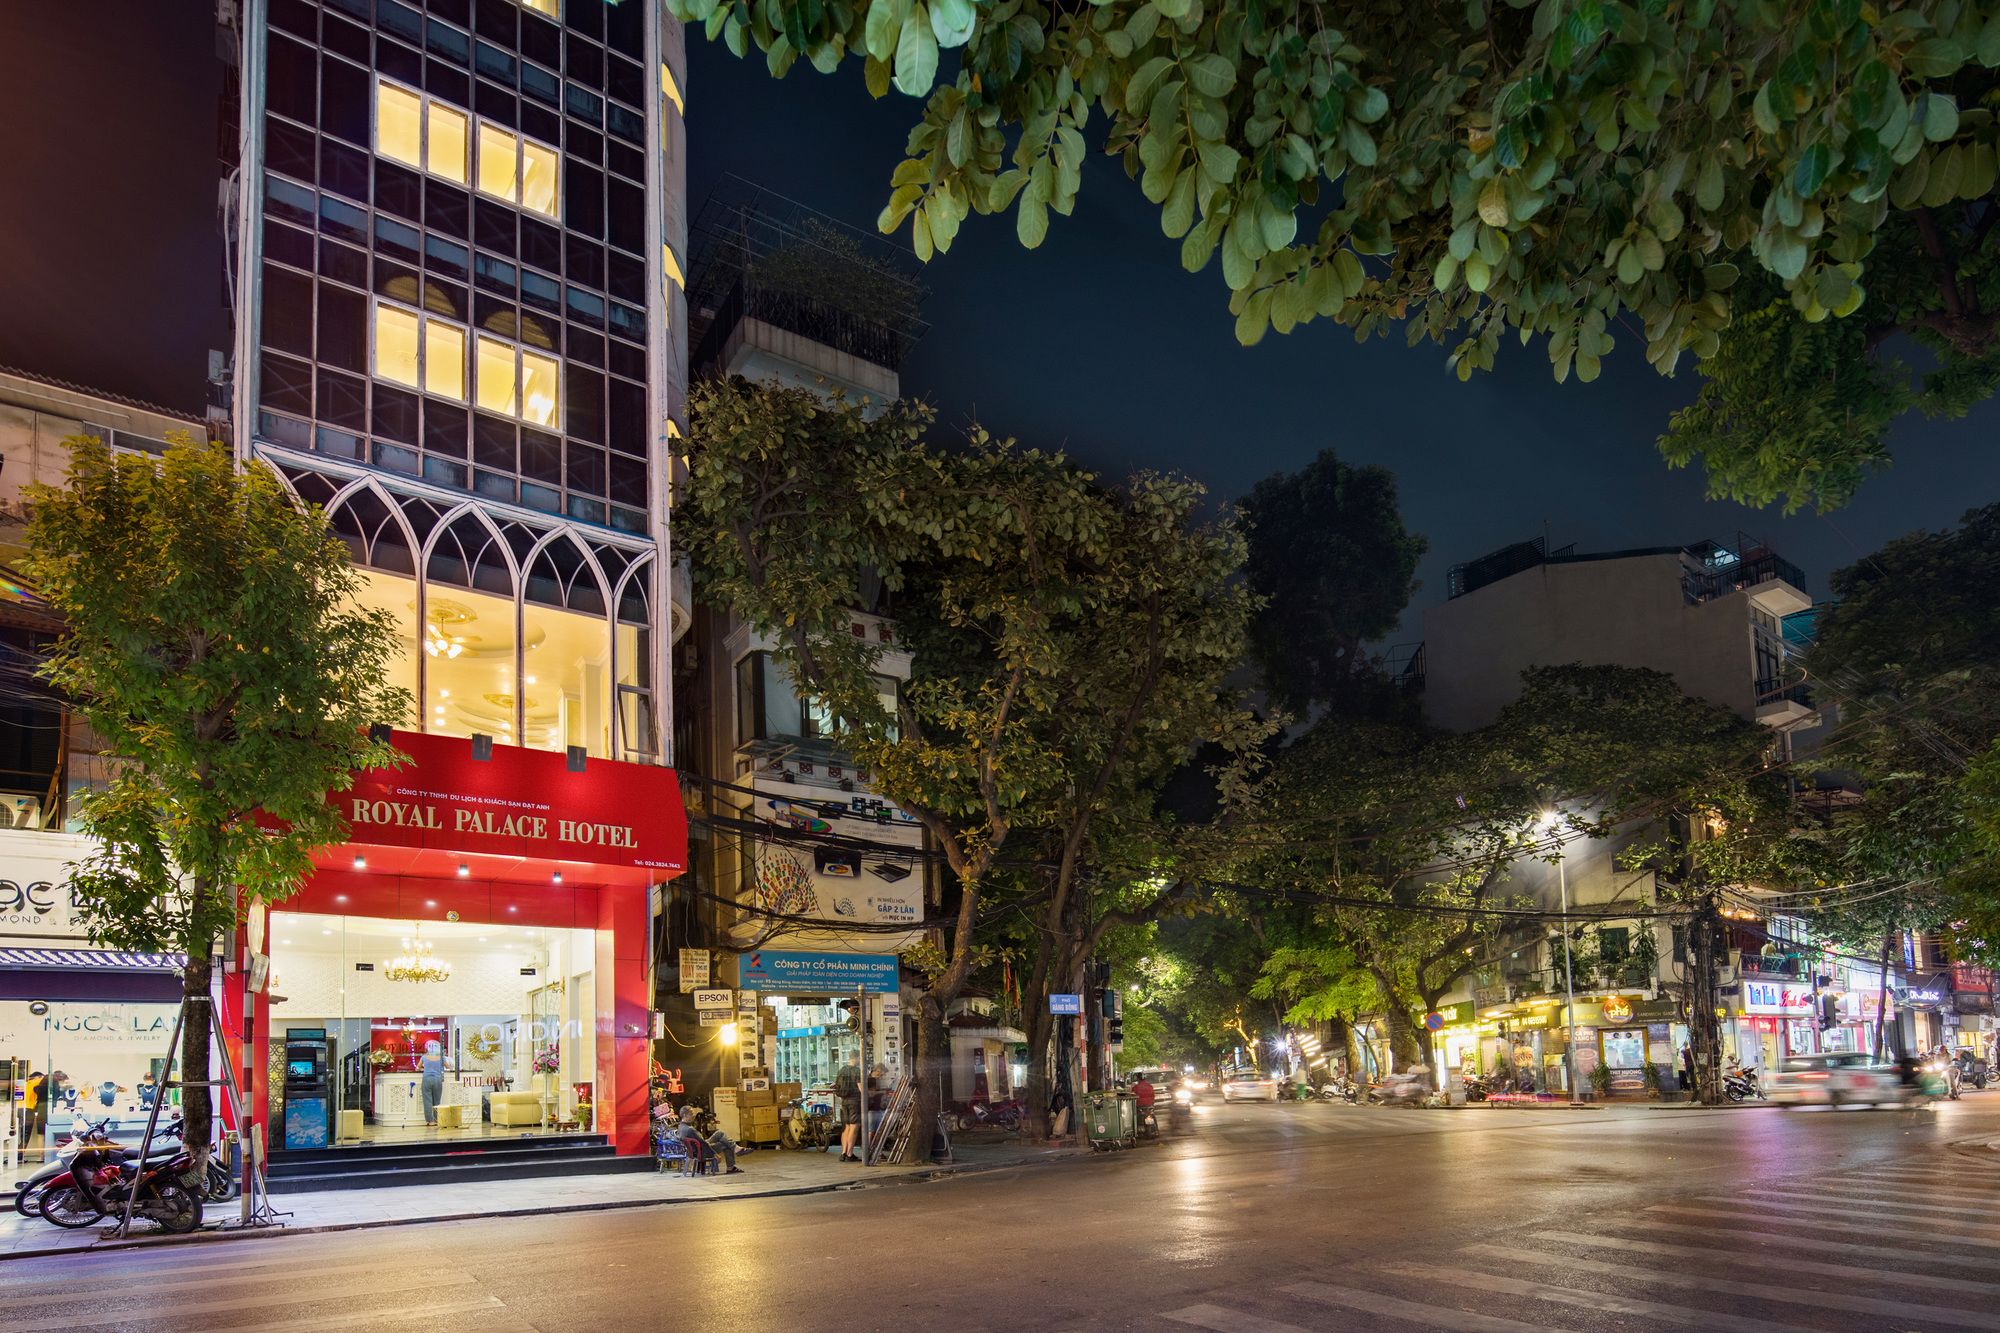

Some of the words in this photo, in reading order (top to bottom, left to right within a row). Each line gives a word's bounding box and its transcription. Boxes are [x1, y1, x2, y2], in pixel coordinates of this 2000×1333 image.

[396, 788, 418, 797] CÔNG
[429, 792, 448, 800] TNHH
[484, 797, 507, 806] KHÁCH
[536, 803, 550, 811] ANH
[352, 799, 442, 829] ROYAL
[454, 809, 548, 839] PALACE
[558, 819, 638, 849] HOTEL
[774, 960, 800, 969] CÔNG
[801, 961, 811, 969] TY
[813, 958, 826, 969] CỔ
[827, 960, 849, 970] PHẦN
[850, 963, 869, 971] MINH
[871, 961, 894, 972] CHÍNH
[699, 994, 728, 1002] EPSON
[463, 1076, 483, 1087] PULL
